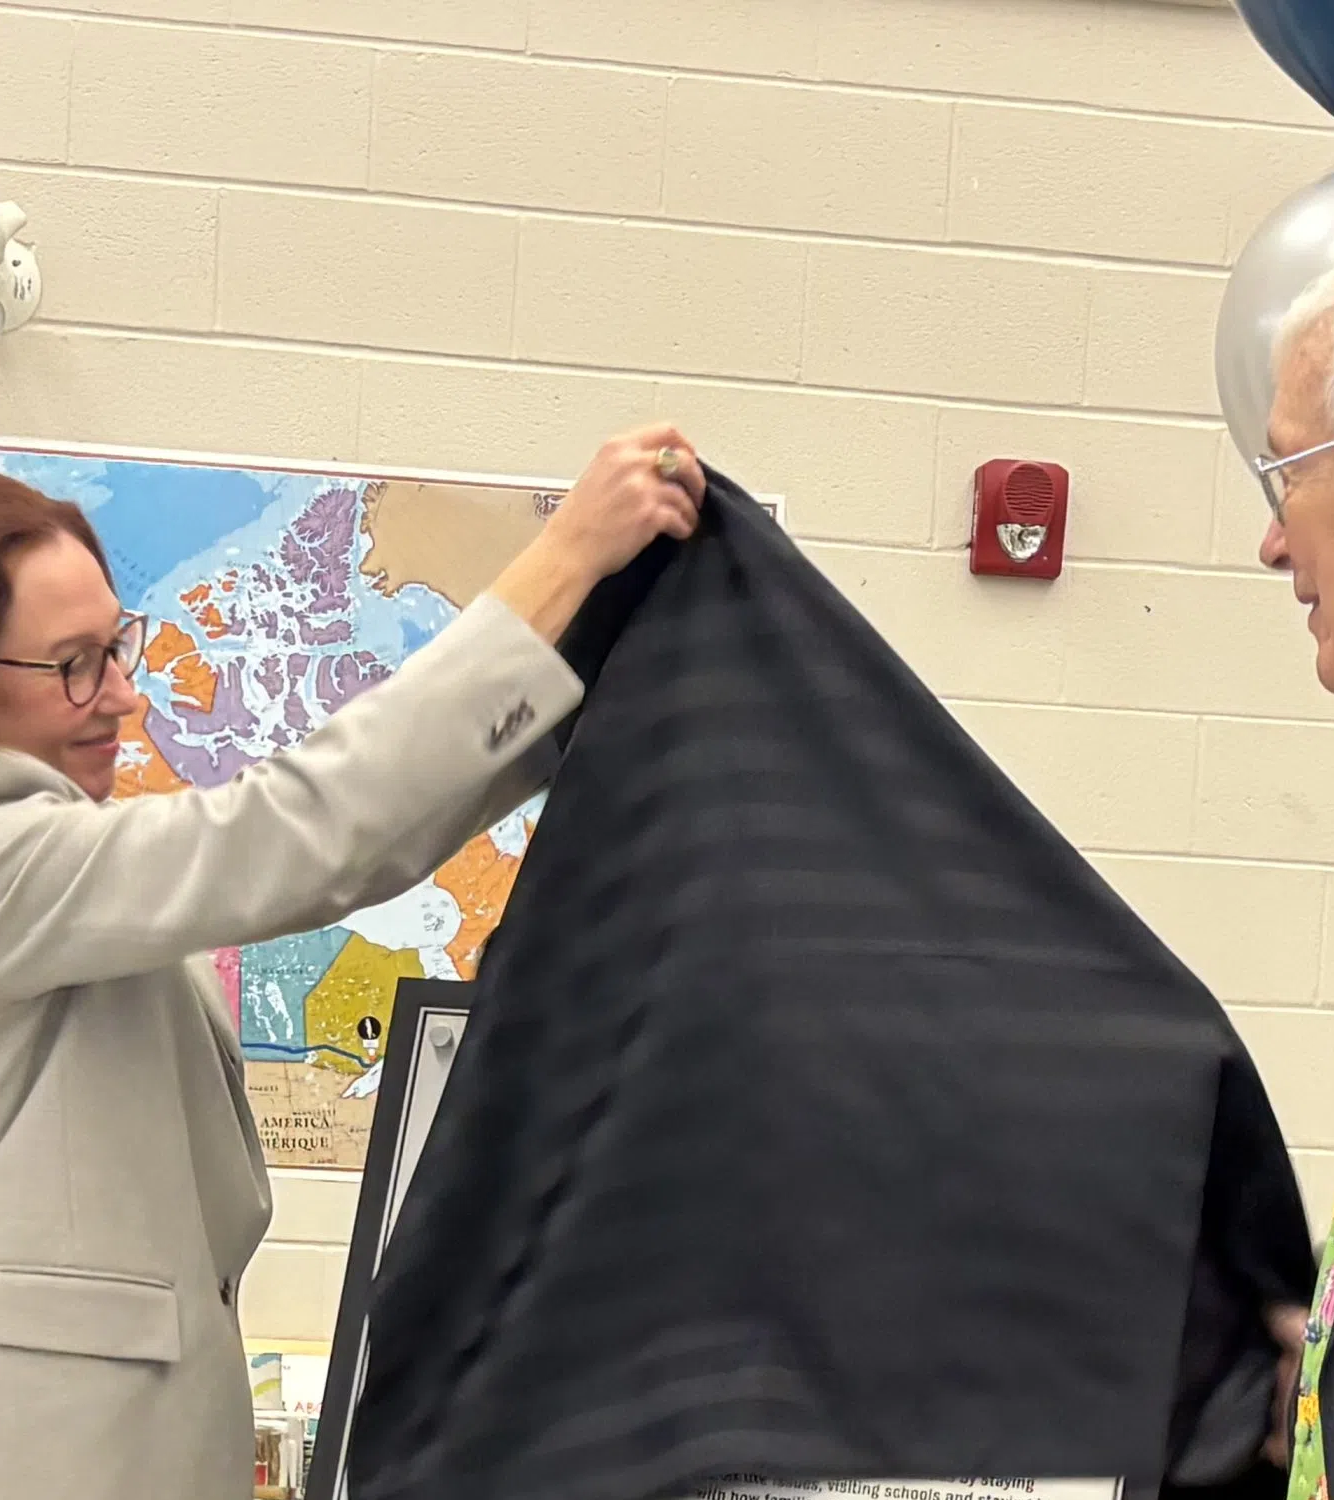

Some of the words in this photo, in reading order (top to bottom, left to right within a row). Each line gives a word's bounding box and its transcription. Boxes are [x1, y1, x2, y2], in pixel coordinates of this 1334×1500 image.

[260, 1117, 330, 1128] AMERICA
[696, 1484, 726, 1500] with
[827, 1480, 880, 1498] visiting
